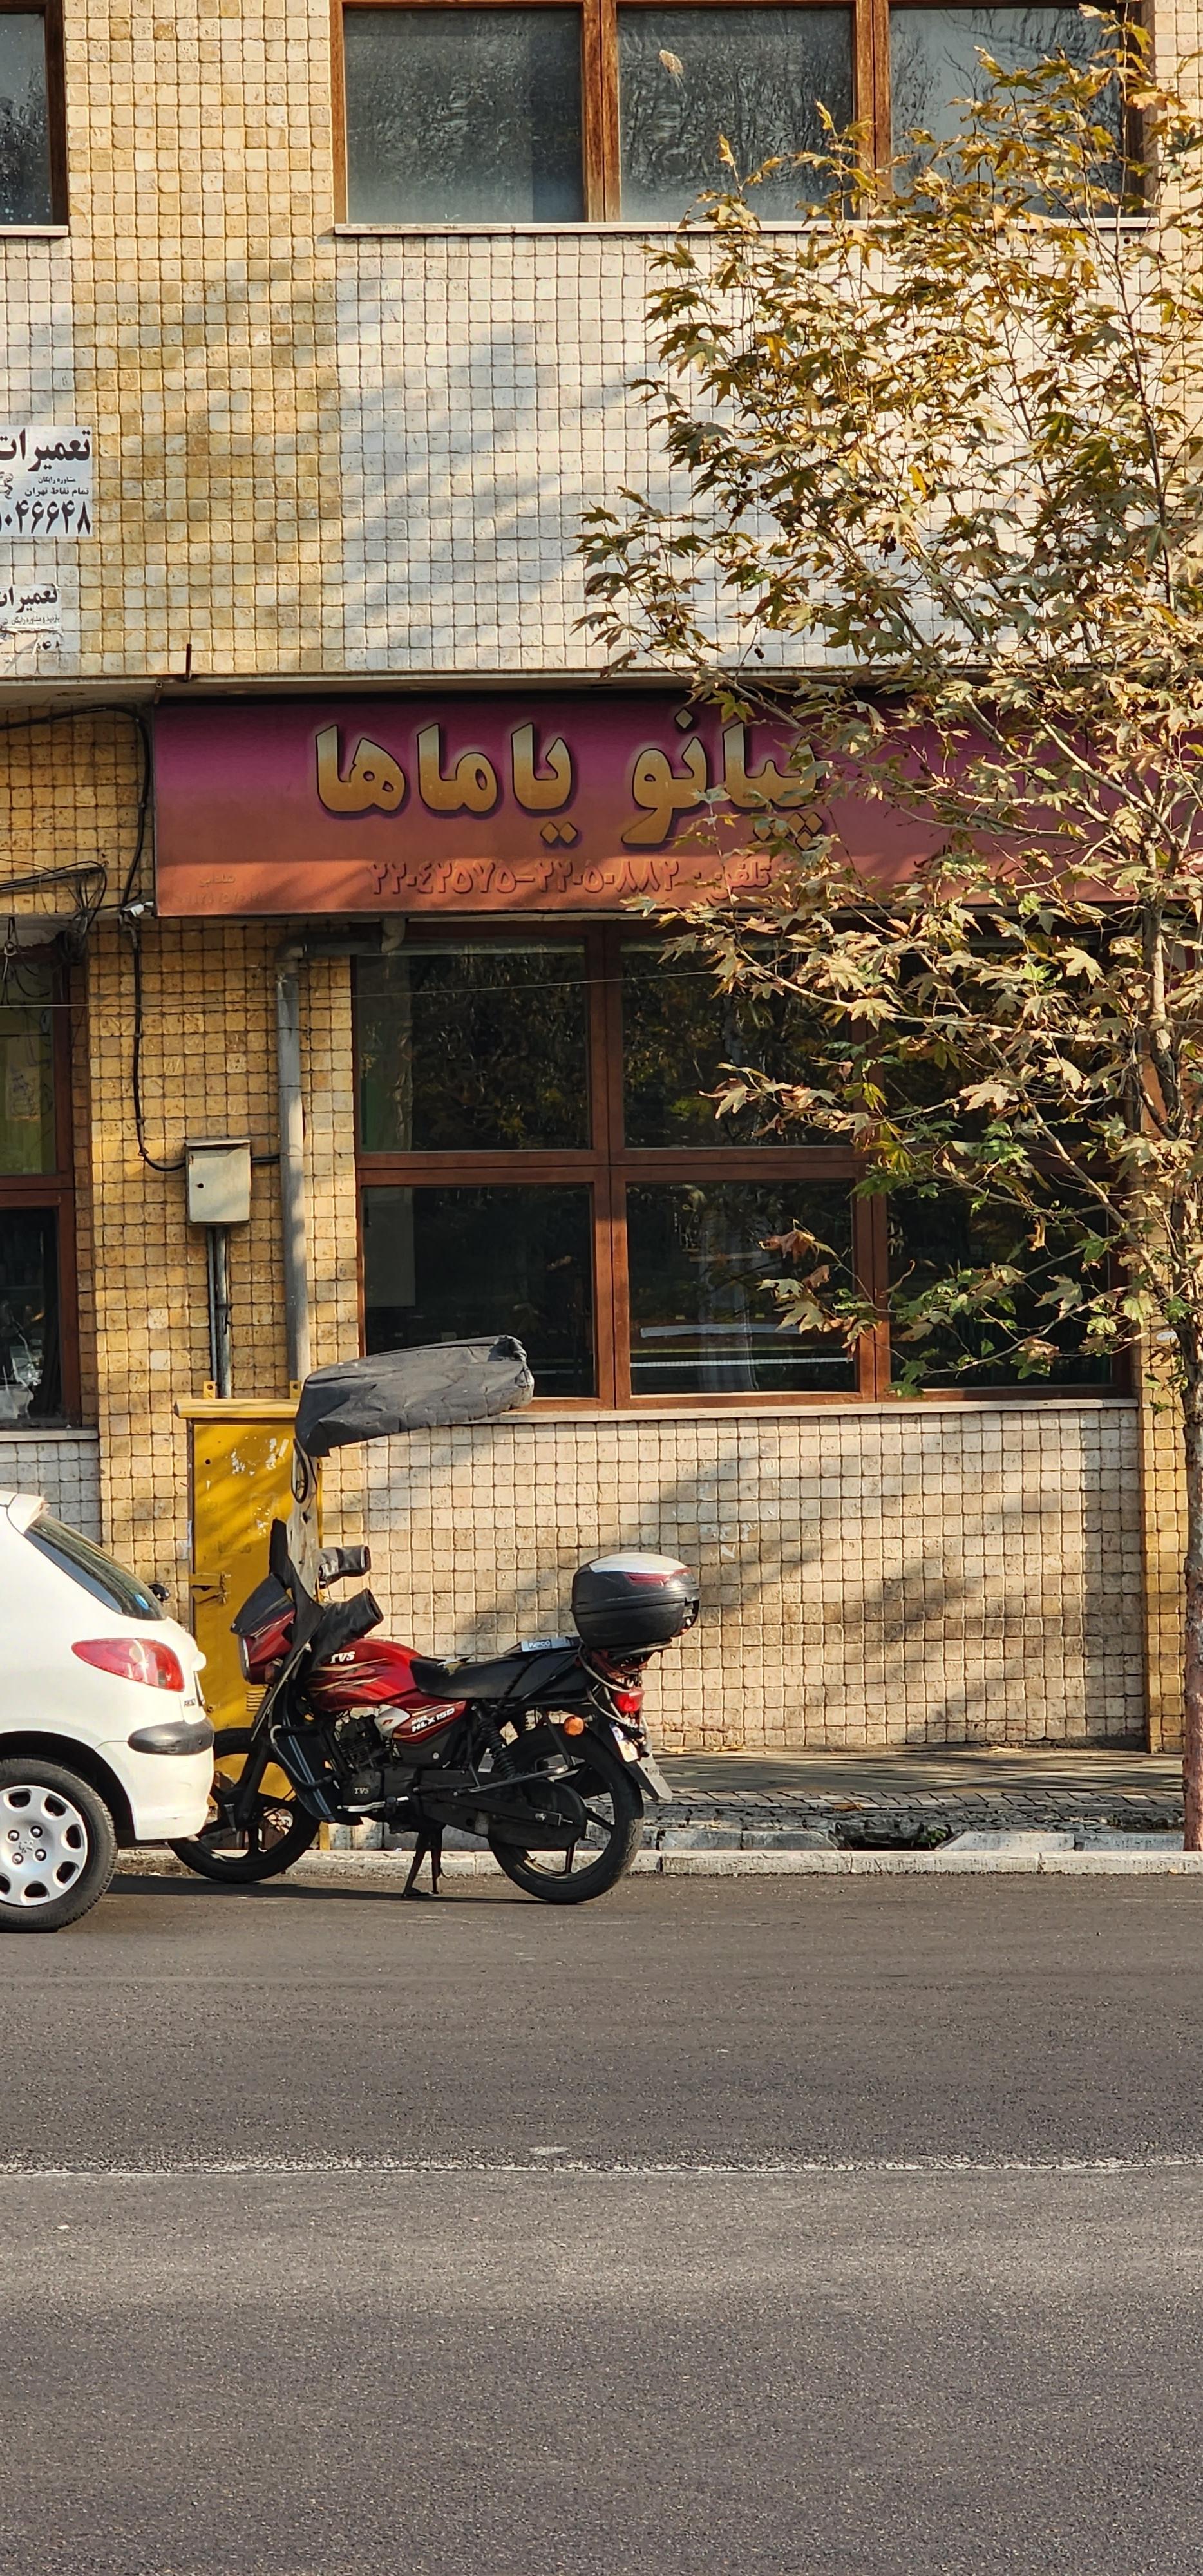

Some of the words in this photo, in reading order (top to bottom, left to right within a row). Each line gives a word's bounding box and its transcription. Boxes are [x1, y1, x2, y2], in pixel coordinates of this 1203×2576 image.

[24, 487, 48, 497] تهران
[50, 487, 70, 495] نقاط
[71, 487, 89, 497] تمام
[0, 499, 91, 535] ۰۴۶۶۴۸
[316, 722, 578, 845] یاماها
[622, 708, 823, 850] پیانو
[330, 1651, 355, 1664] TVS
